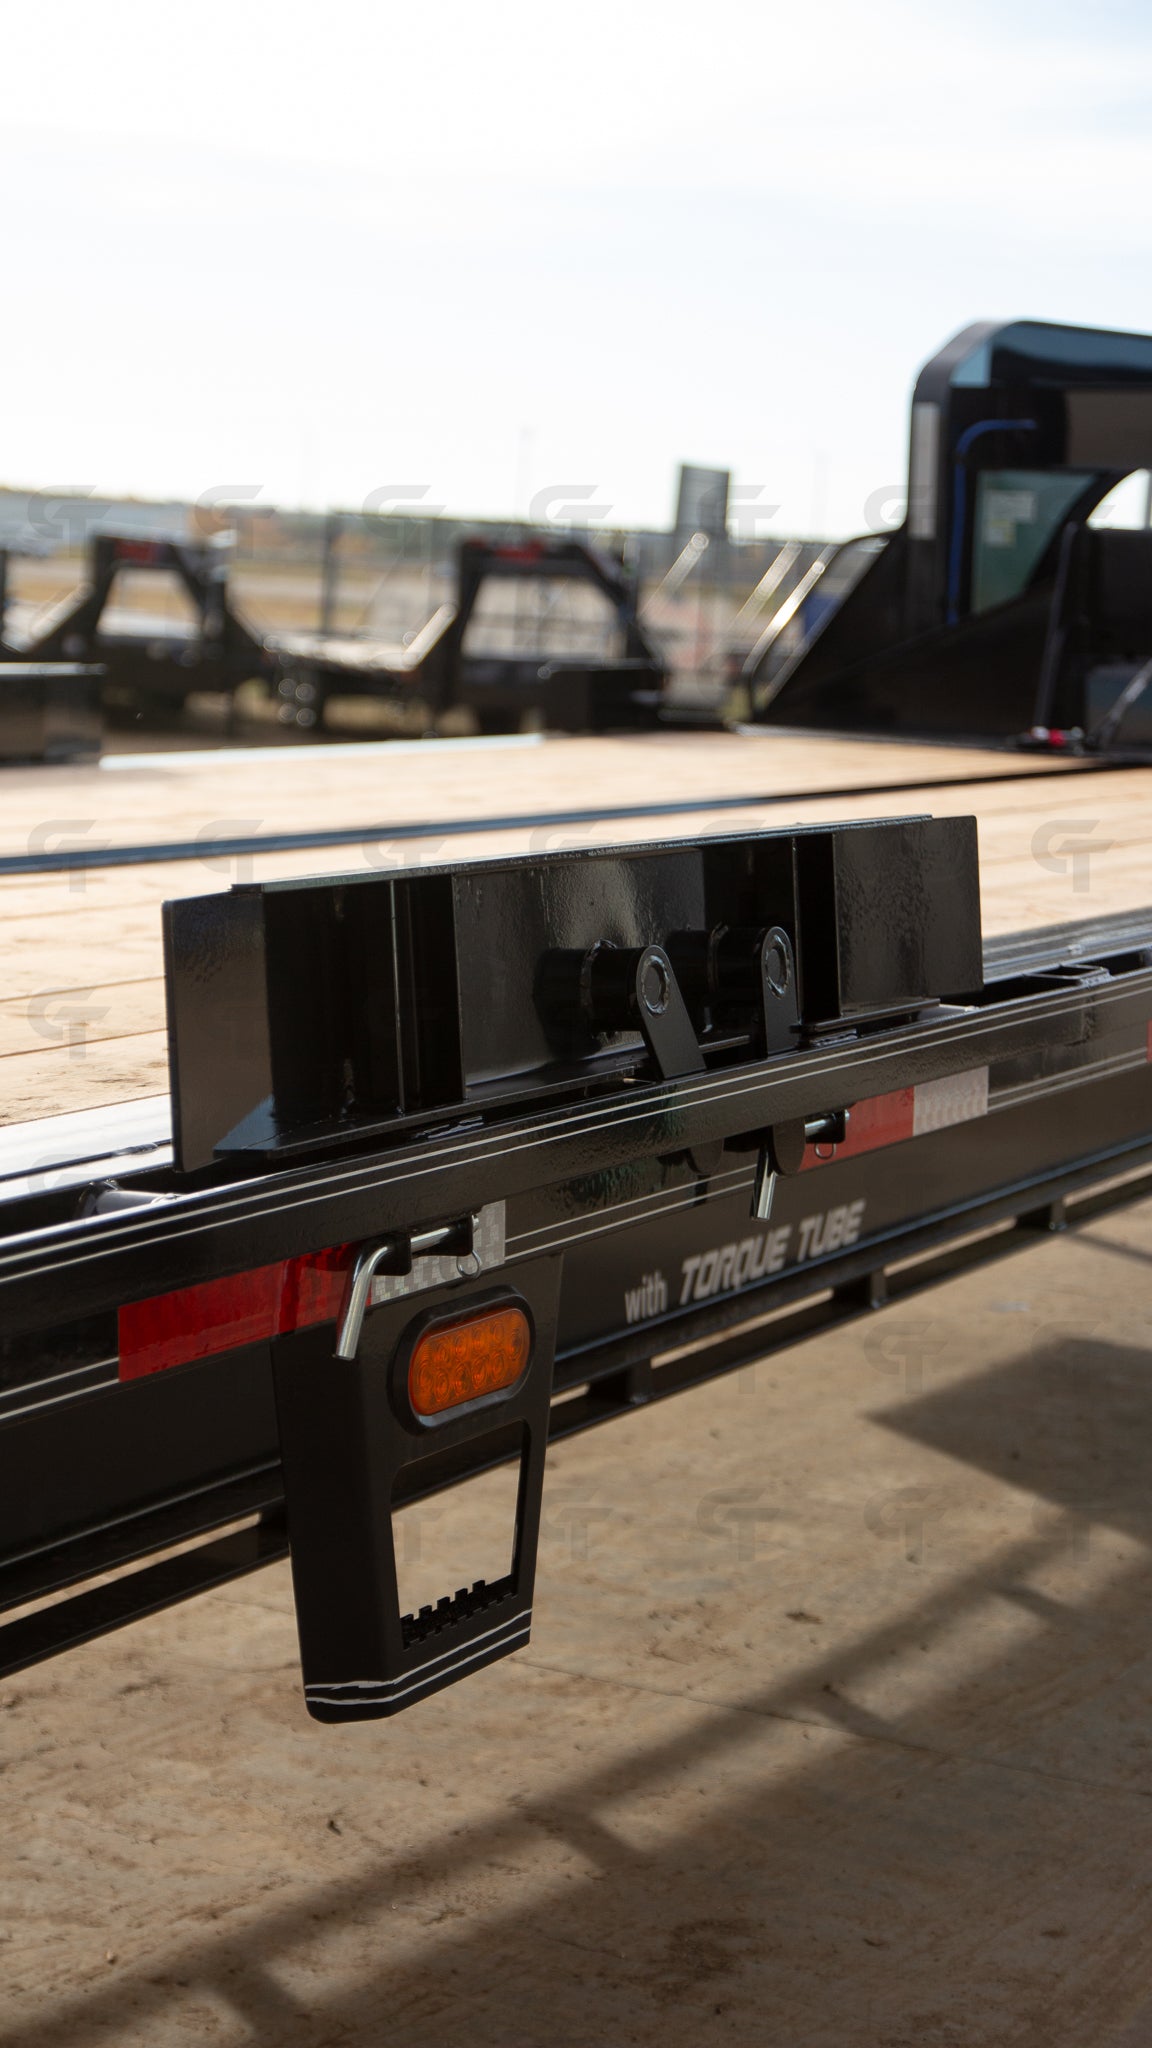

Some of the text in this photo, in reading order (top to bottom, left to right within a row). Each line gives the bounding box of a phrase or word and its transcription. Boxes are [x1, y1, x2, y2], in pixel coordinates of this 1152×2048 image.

[625, 1200, 866, 1323] with TORQUE TUBE
